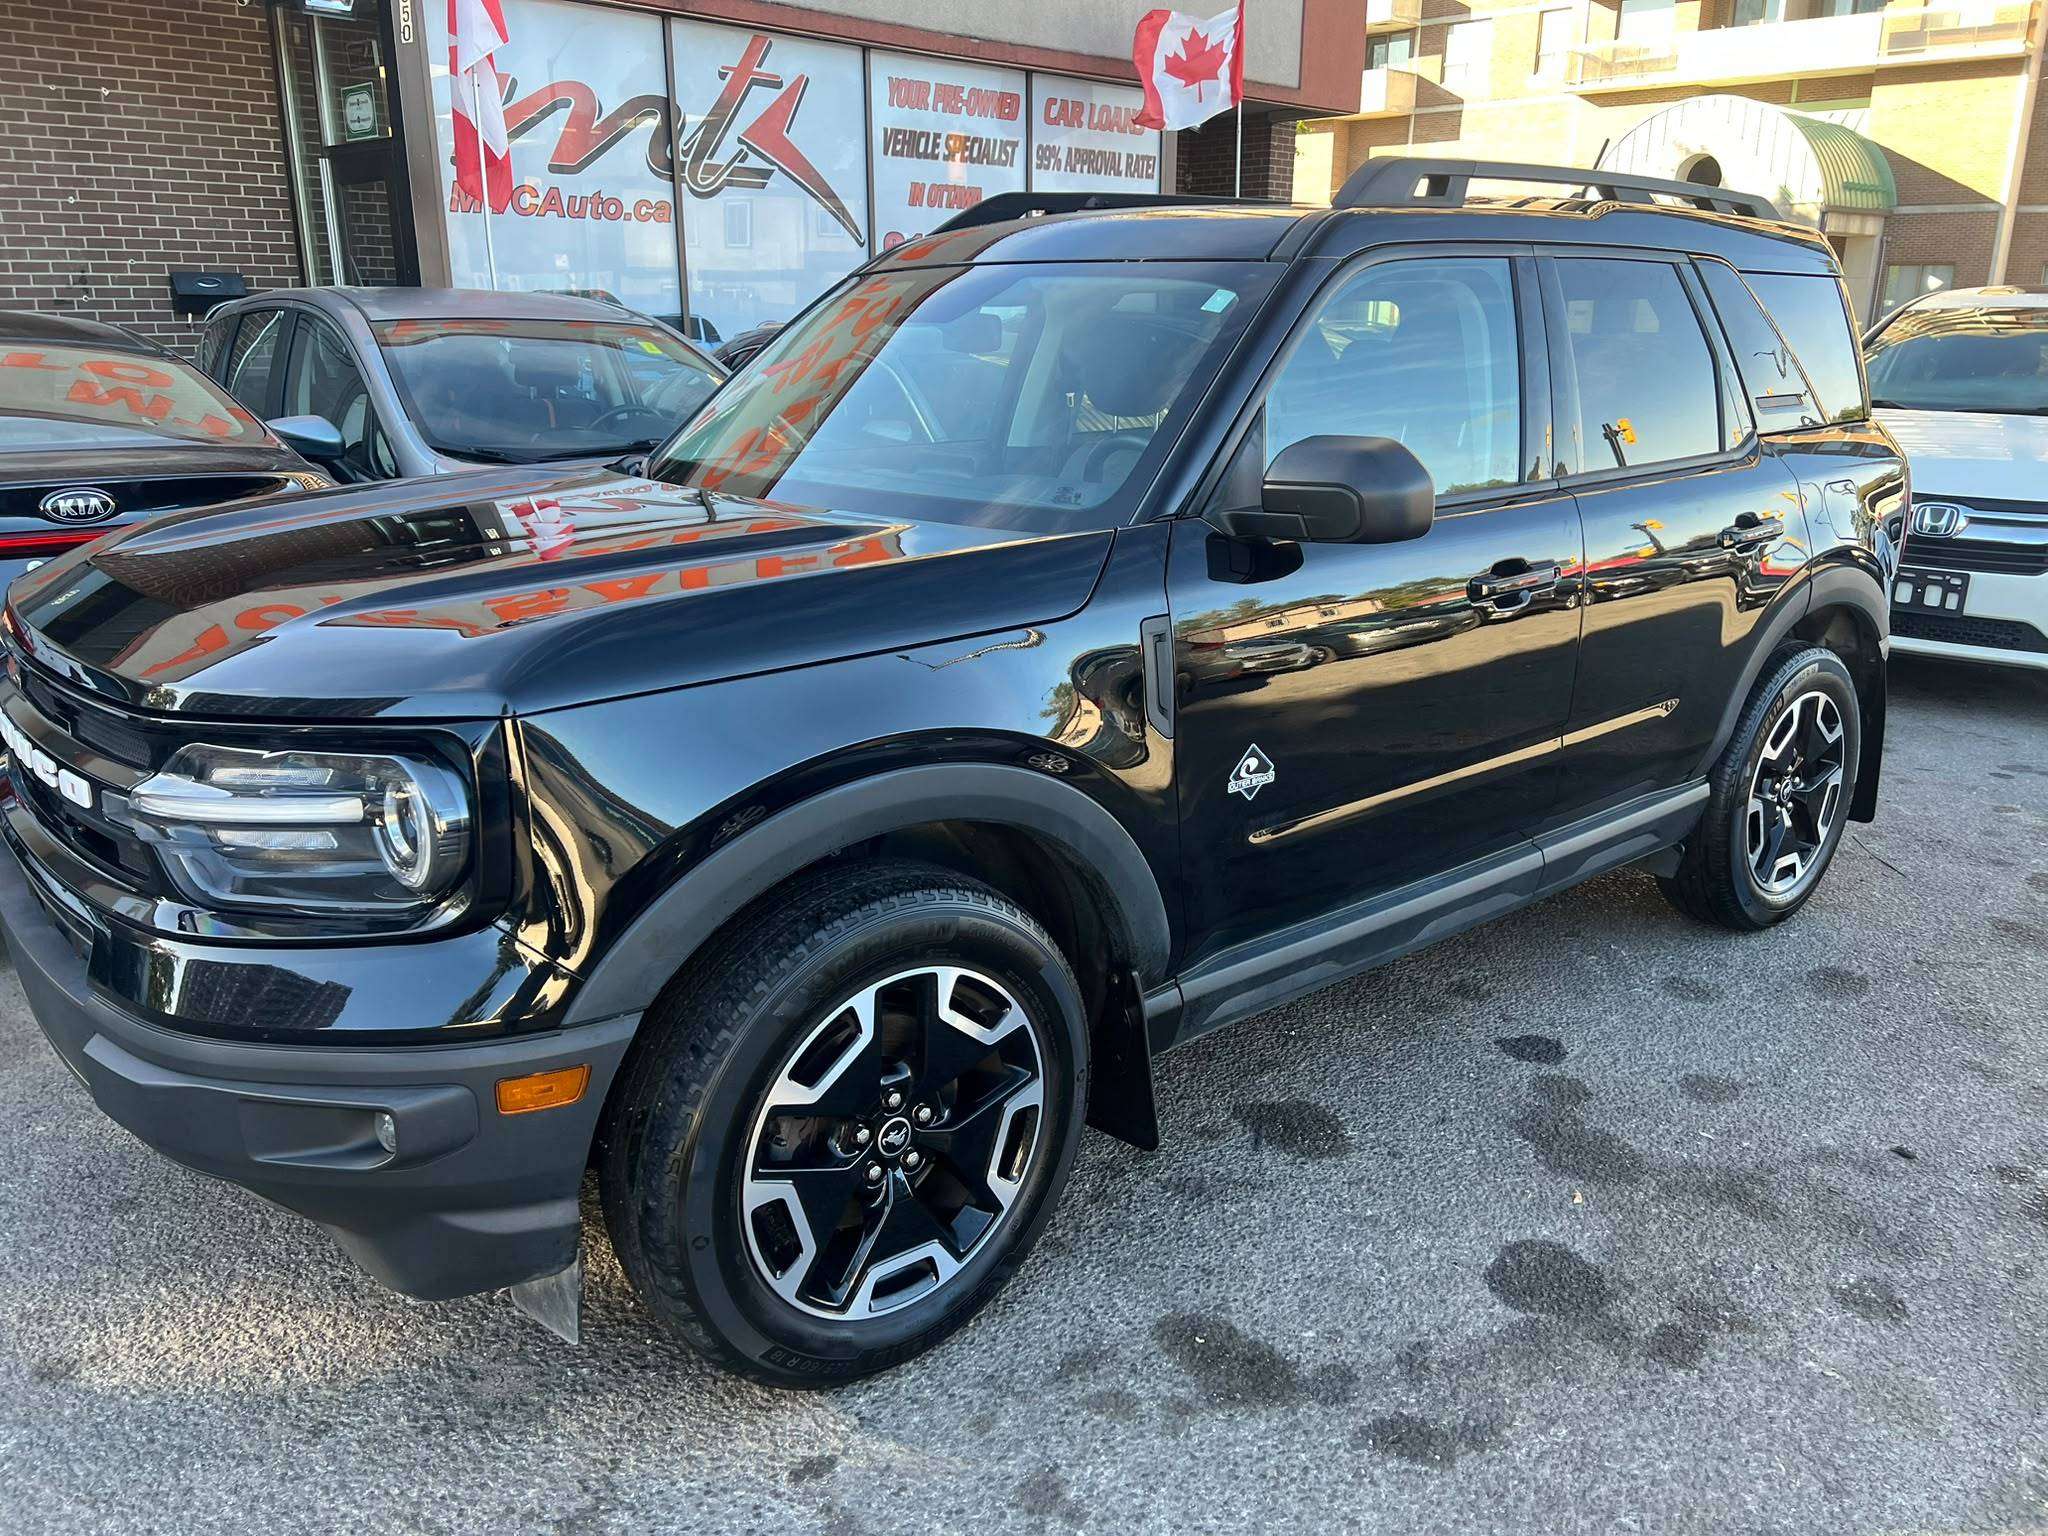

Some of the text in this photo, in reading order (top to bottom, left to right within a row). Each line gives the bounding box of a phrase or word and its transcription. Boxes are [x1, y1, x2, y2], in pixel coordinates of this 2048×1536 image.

[401, 0, 411, 42] 50
[888, 76, 1020, 121] YOUR PRE-OWNED
[1044, 97, 1084, 128] CAR
[883, 127, 1018, 167] VEHICLE SPECIALIST
[1036, 143, 1157, 180] 99% APPROVAL RATE!
[450, 181, 672, 223] MCAuto.ca
[908, 182, 983, 210] IN OTTAWA
[57, 497, 104, 516] KIA
